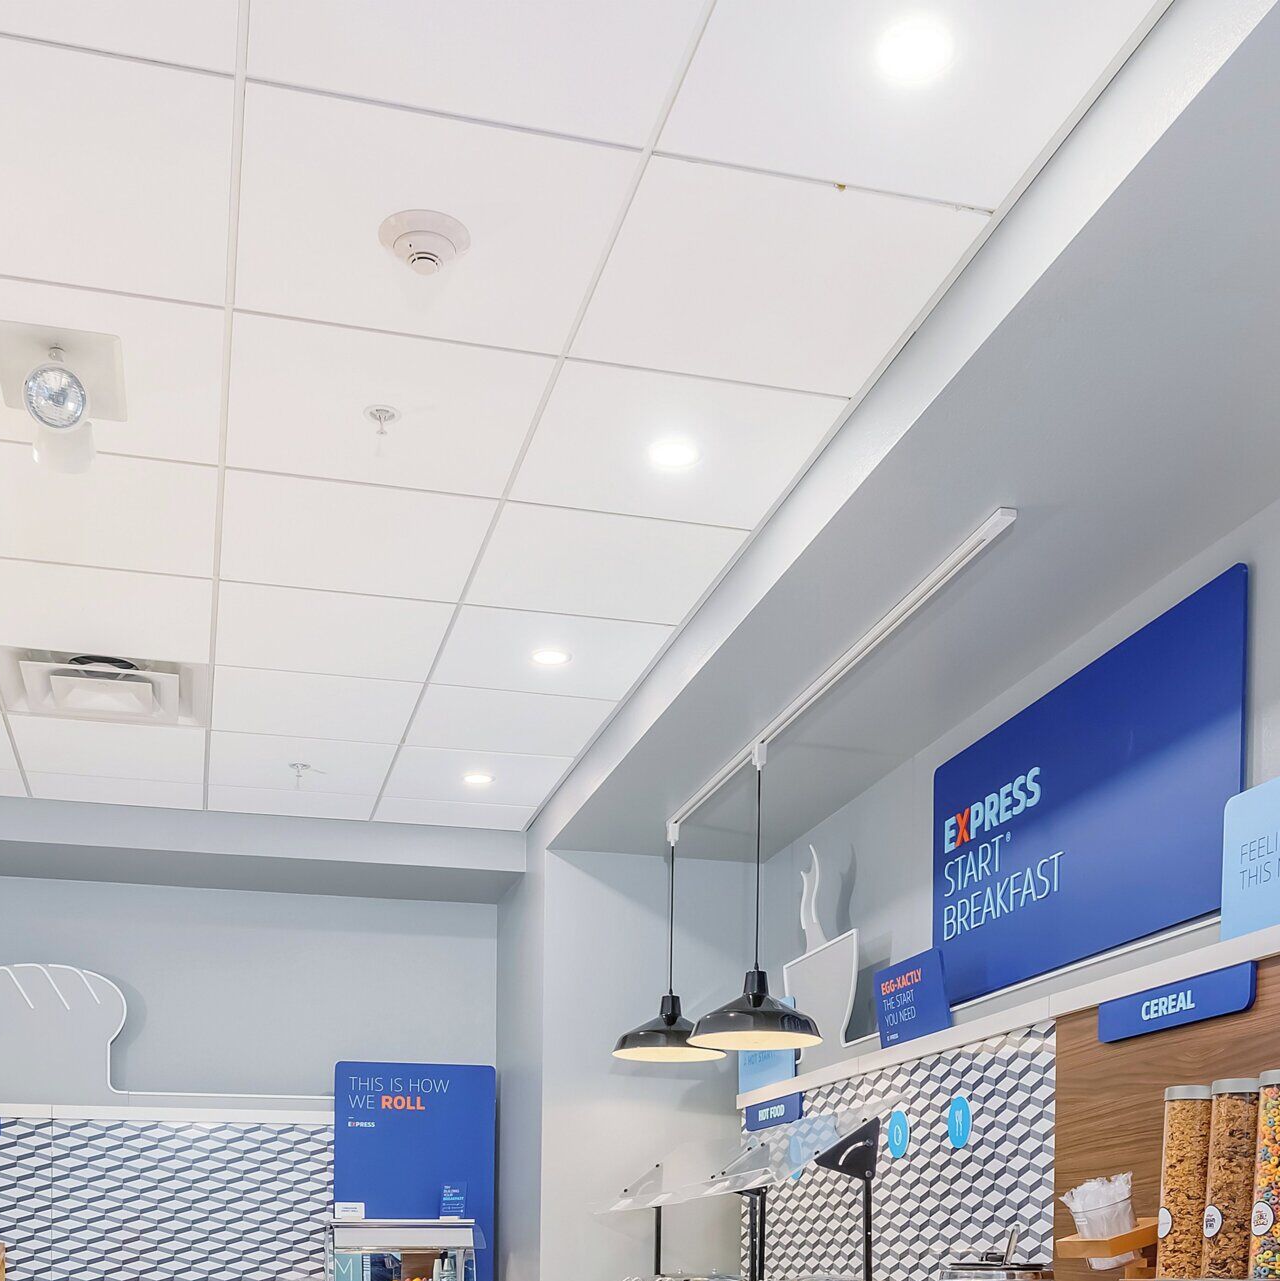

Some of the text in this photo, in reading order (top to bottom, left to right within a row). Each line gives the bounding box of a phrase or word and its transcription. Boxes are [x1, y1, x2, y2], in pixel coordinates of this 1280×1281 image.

[944, 767, 1042, 854] EXPRESS
[1239, 862, 1272, 890] THIS
[943, 851, 1065, 942] BREAKFAST
[880, 968, 922, 996] EGG-XACTLY
[883, 989, 914, 1011] THE START
[1141, 989, 1196, 1021] CEREAL
[884, 1006, 917, 1027] YOU NEED
[349, 1076, 450, 1093] THIS IS HOW
[348, 1094, 426, 1111] WE ROLL
[758, 1104, 785, 1121] HOT FOOD
